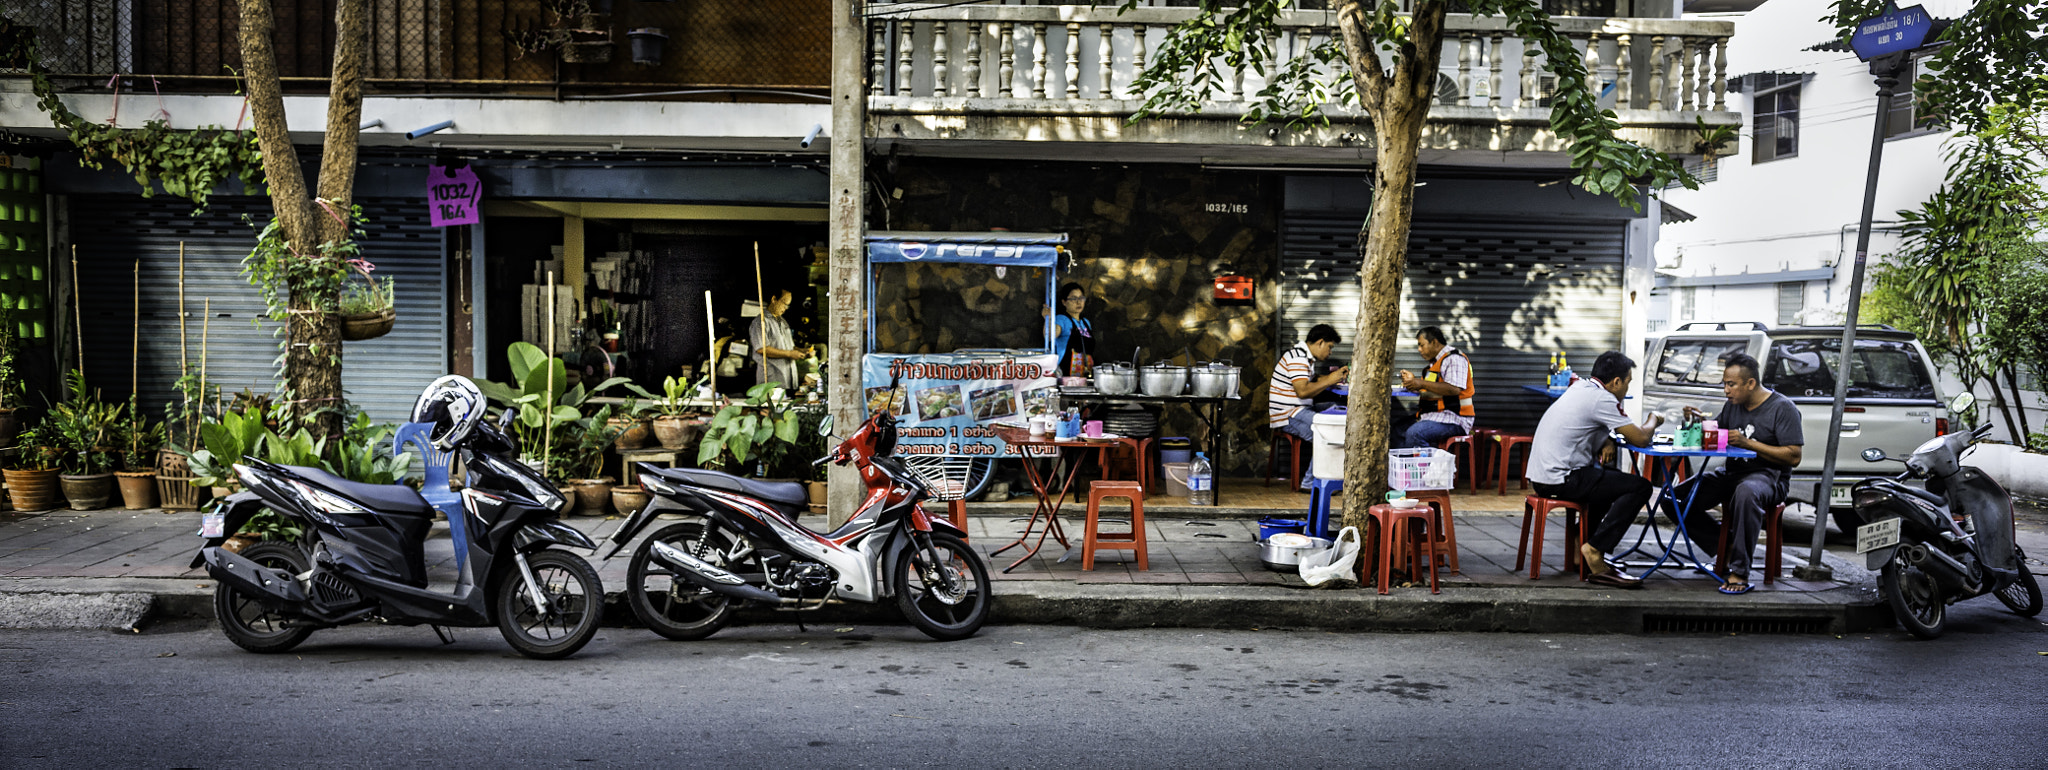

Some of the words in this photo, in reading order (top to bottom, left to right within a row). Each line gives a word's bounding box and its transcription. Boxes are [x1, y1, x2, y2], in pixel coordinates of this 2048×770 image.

[1902, 13, 1920, 26] 18/1
[1895, 31, 1903, 41] 30
[431, 181, 480, 208] 1032/
[437, 204, 466, 220] 164
[1205, 203, 1248, 213] 1032/165
[949, 425, 958, 438] 1
[949, 442, 960, 454] 2
